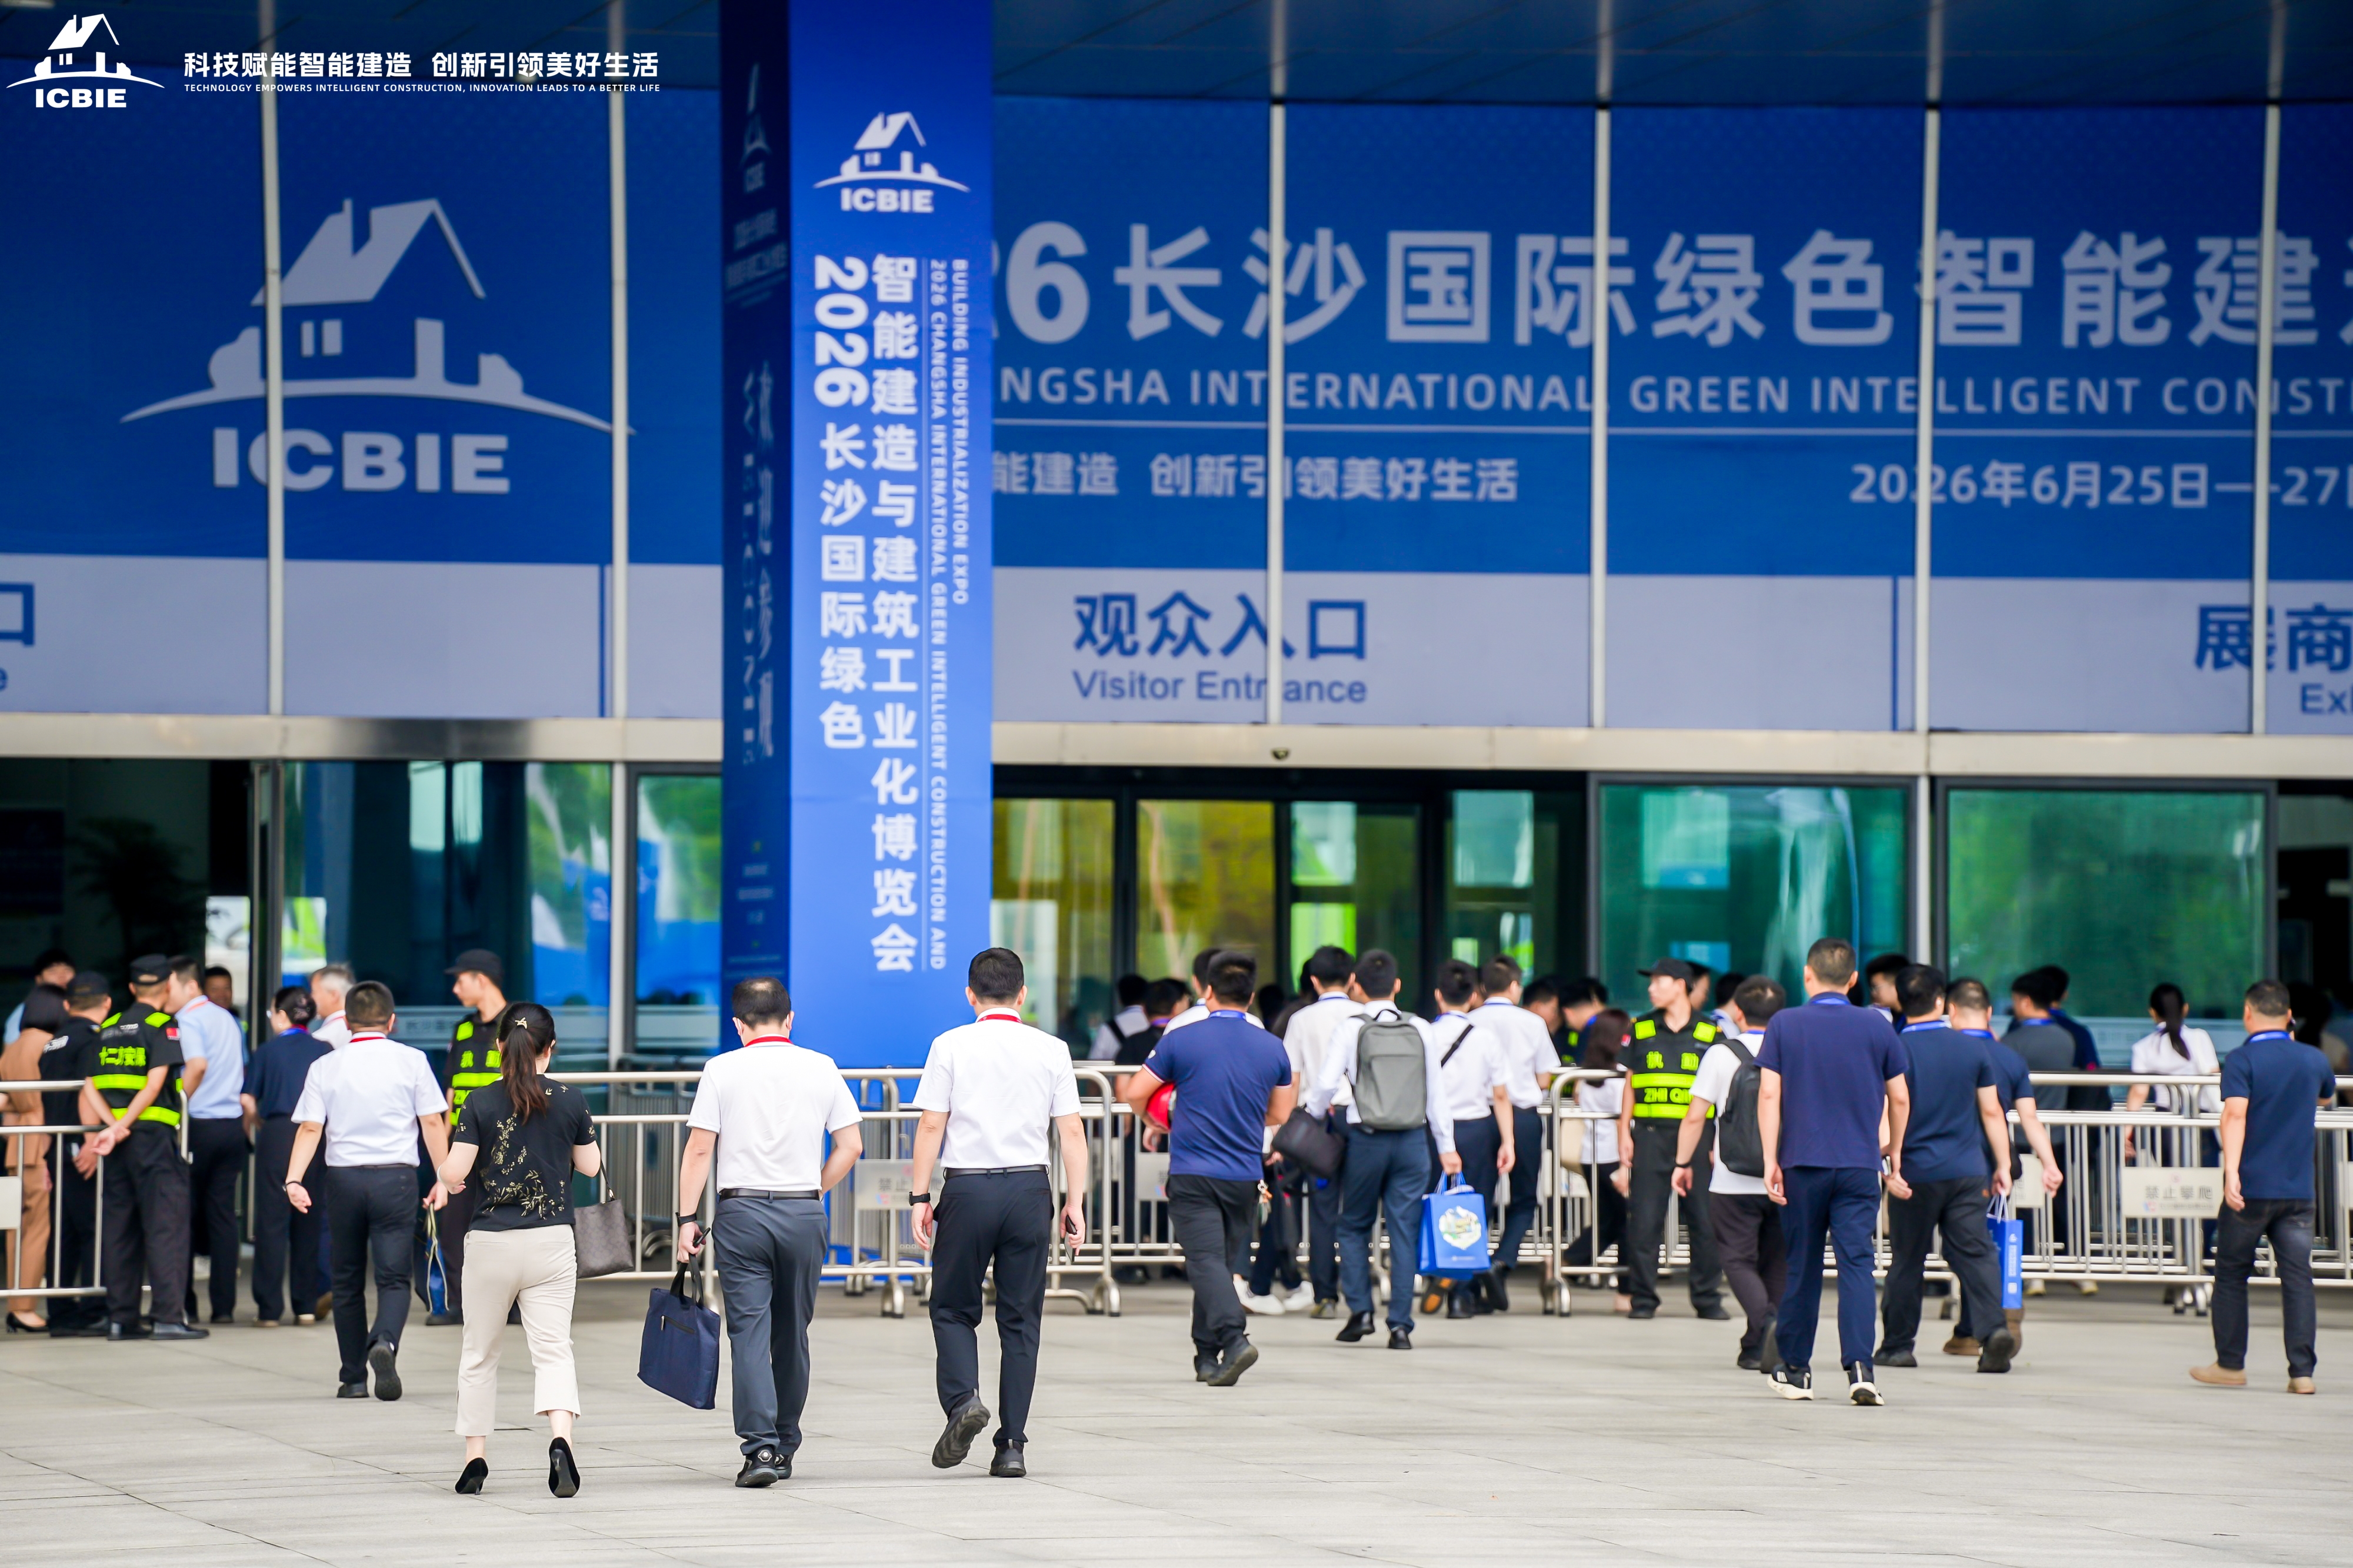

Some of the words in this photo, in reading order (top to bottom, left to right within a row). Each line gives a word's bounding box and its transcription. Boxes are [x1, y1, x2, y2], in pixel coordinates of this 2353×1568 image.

[841, 187, 934, 213] ICBIE
[930, 260, 948, 305] 2026
[952, 259, 969, 351] BUILDING
[992, 221, 2353, 348] 6长沙国际绿色智能建
[930, 311, 948, 419] CHANGSHA
[1000, 366, 1171, 405] NGSHA
[1190, 371, 1609, 412] INTERNATIONAL
[1629, 375, 1789, 413] GREEN
[1811, 376, 2140, 414] INTELLIGENT
[2161, 378, 2353, 415] CONST
[213, 427, 510, 495] ICBIE
[952, 357, 969, 549] INDUSTRIALIZATION
[1149, 453, 1518, 501] 创新引领美好生活
[930, 424, 948, 576] INTERNATIONAL
[952, 553, 969, 605] EXPO
[871, 254, 919, 972] 智能建造与建筑工业化博览会
[930, 582, 948, 645] GREEN
[1074, 590, 1367, 660] 观众入口
[930, 650, 948, 770] INTELLIGENT
[1072, 670, 1184, 700] Visitor
[1196, 672, 1367, 702] Entrance
[2300, 683, 2353, 715] Ex
[930, 775, 948, 922] CONSTRUCTION
[930, 927, 948, 970] AND
[1644, 1087, 1668, 1103] ZHI
